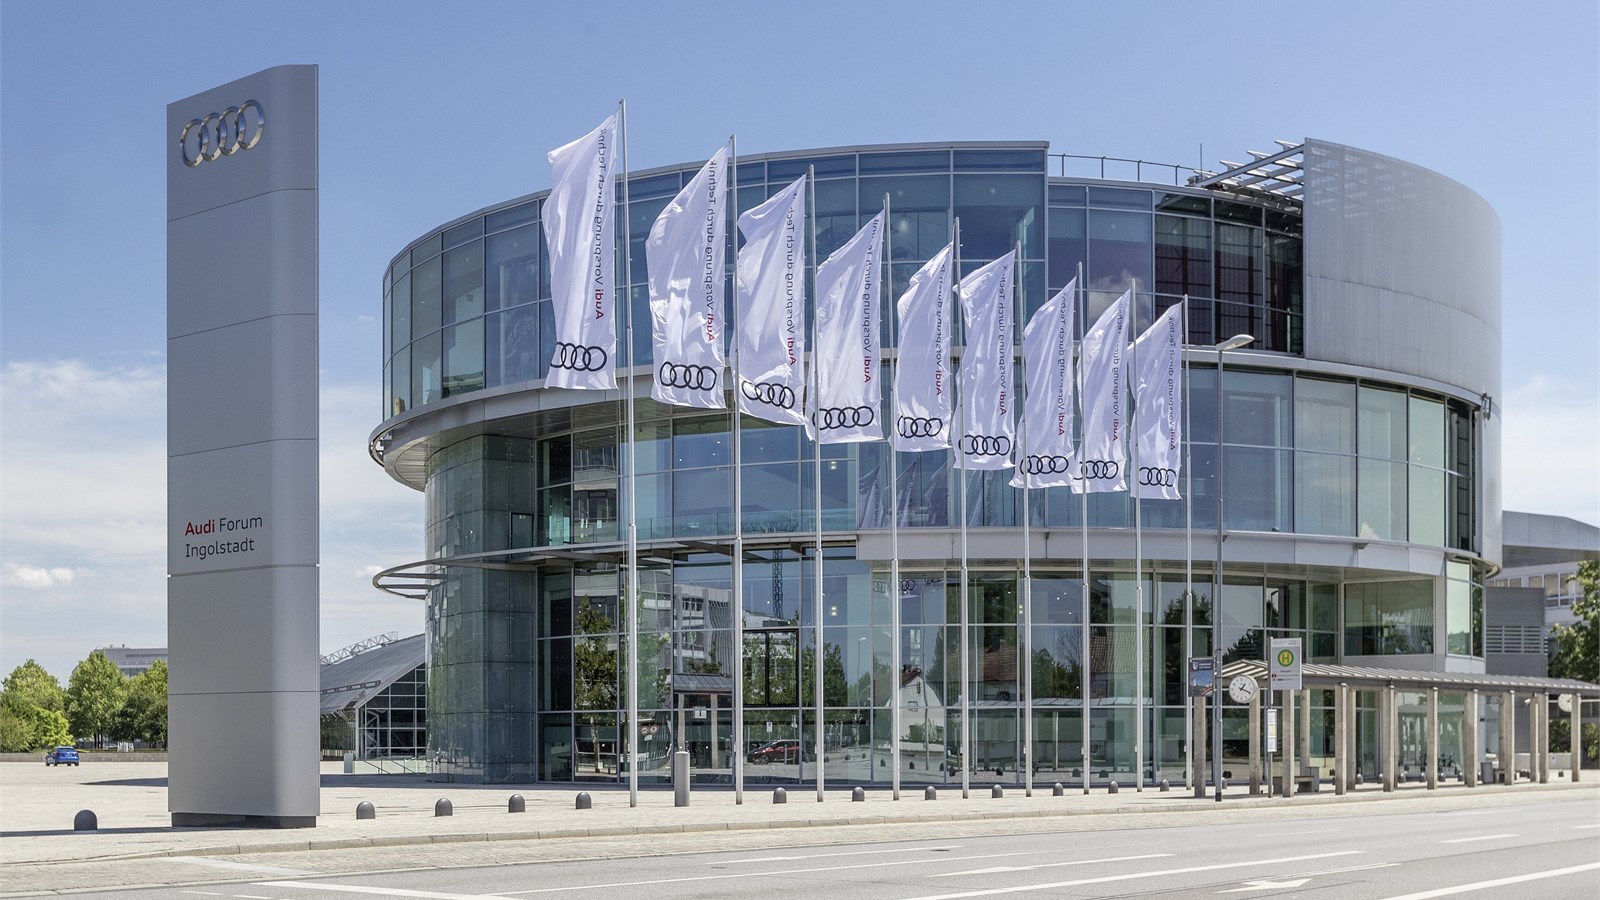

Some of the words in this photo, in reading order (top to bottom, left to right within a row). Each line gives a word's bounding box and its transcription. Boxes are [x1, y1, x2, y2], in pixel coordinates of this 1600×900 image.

[184, 519, 215, 536] Audi
[219, 516, 263, 532] Forum
[185, 537, 255, 560] Ingolstadt
[1282, 653, 1290, 663] H
